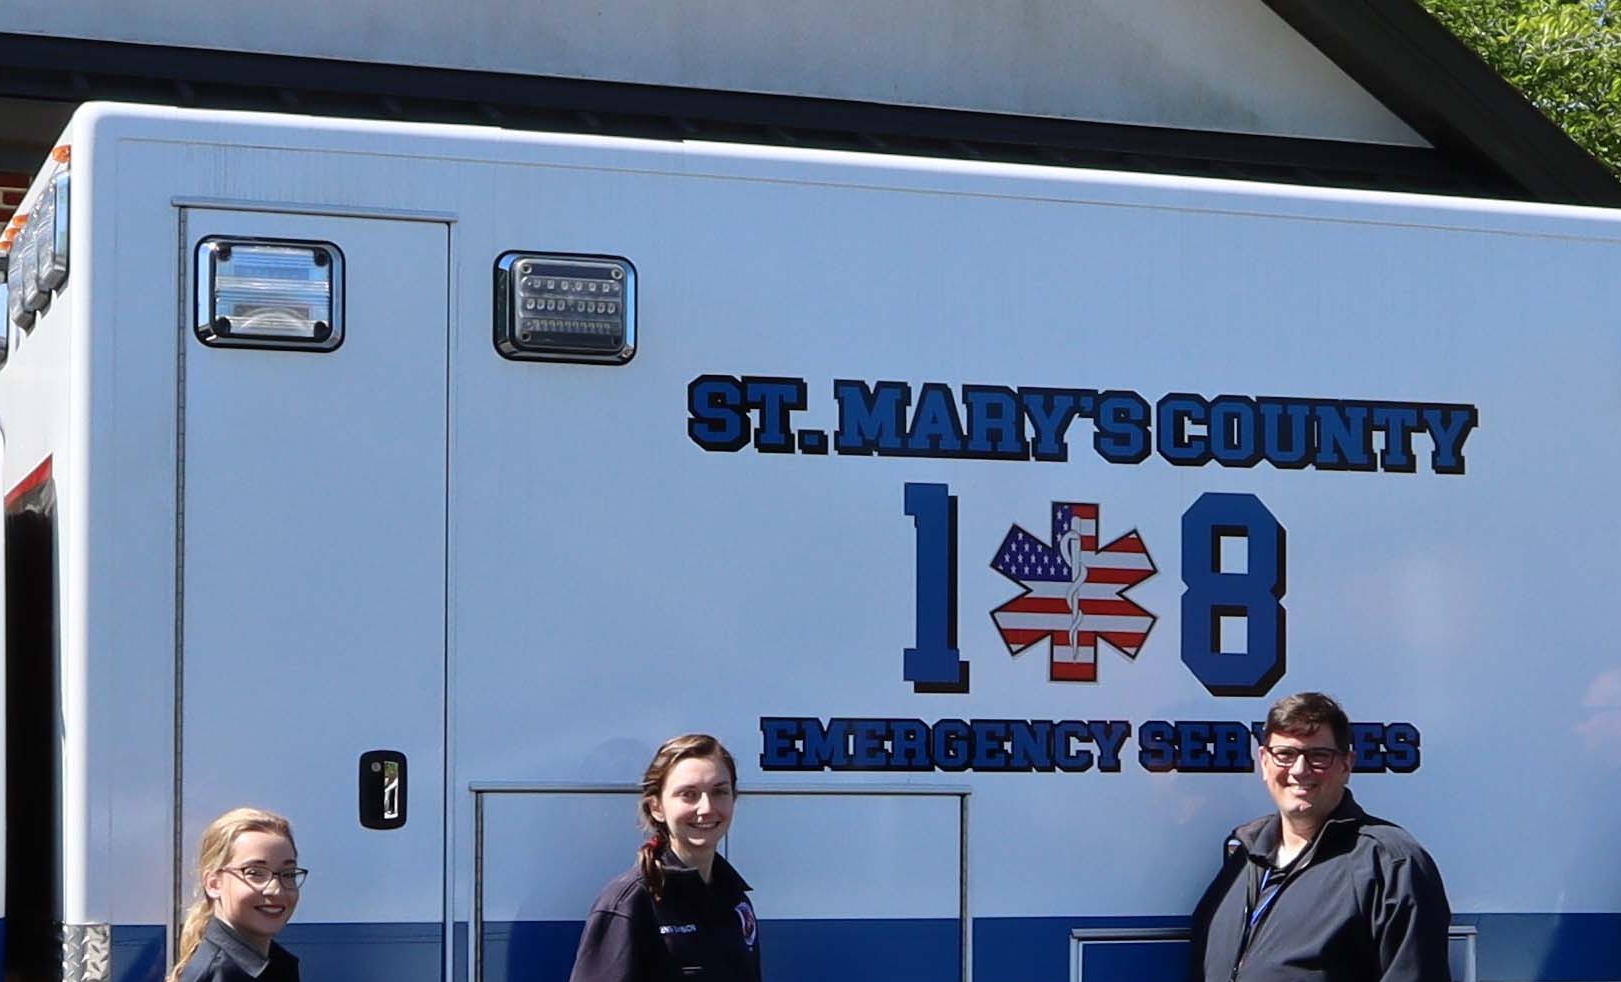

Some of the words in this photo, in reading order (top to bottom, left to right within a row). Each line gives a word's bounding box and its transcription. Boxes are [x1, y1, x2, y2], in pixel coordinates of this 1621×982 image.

[687, 374, 829, 455] ST.
[833, 378, 1153, 464] MARY'S
[1156, 392, 1479, 475] COUNTY
[759, 716, 1132, 773] EMERGENCY
[1137, 719, 1421, 774] SERES
